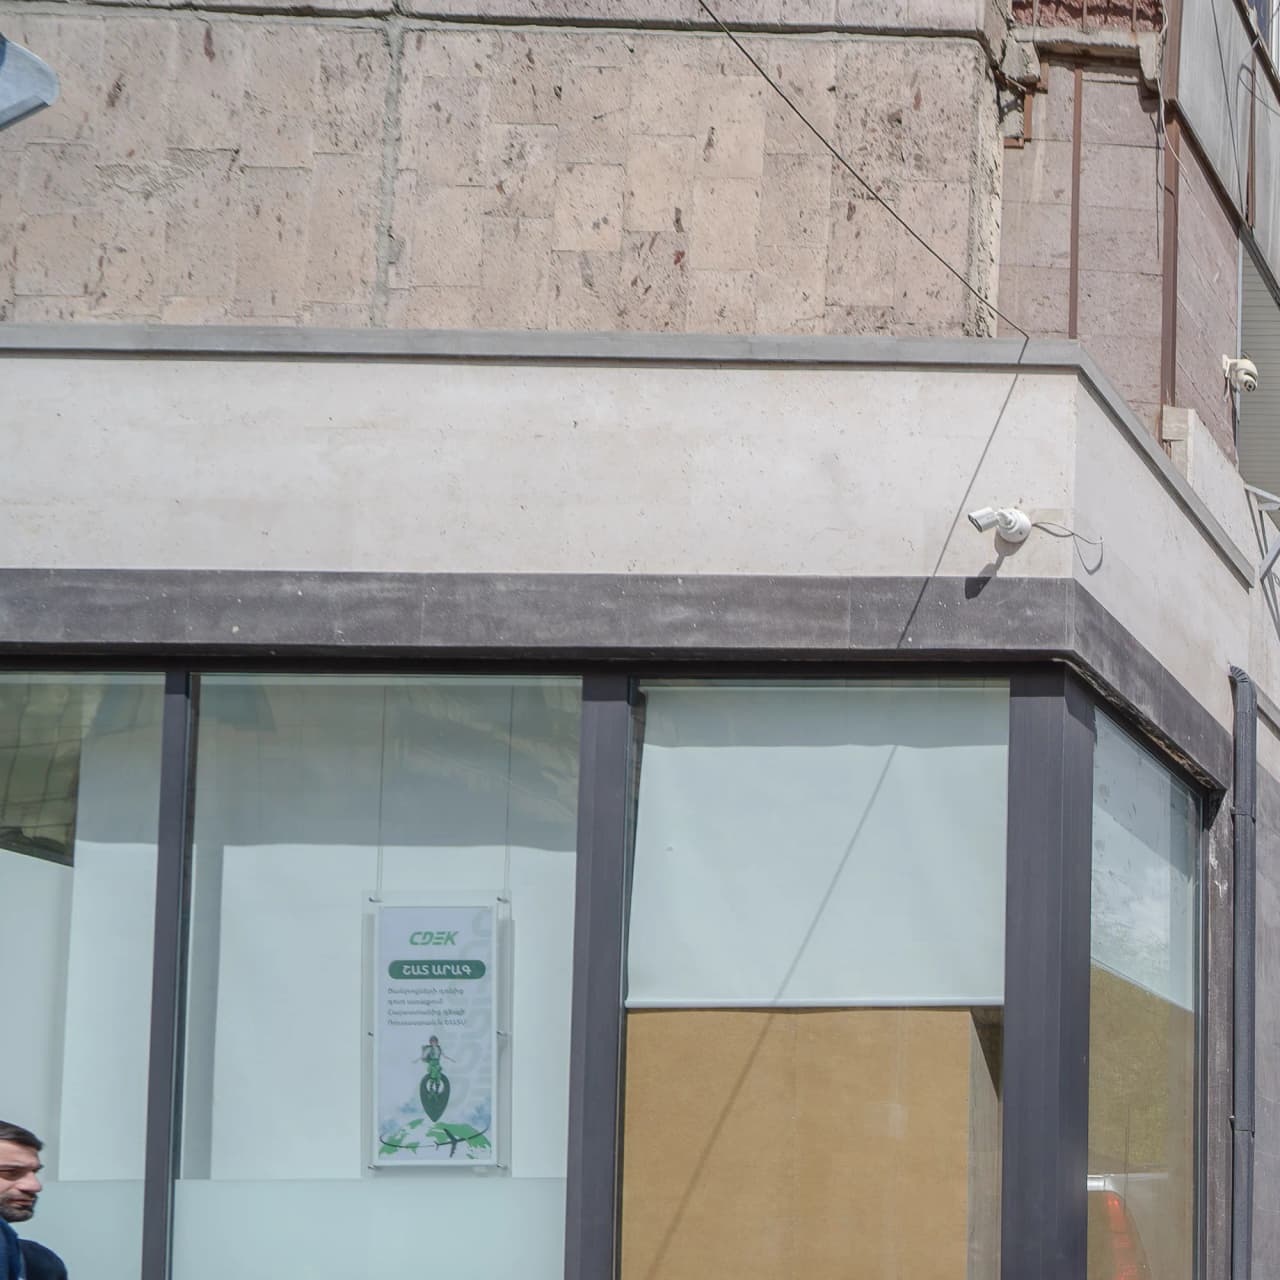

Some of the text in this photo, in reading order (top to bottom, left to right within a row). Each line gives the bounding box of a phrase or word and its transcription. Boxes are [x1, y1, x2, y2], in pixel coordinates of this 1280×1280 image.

[409, 931, 459, 946] CDEK
[402, 964, 472, 976] ՇԱՏ ԱՐԱԳ
